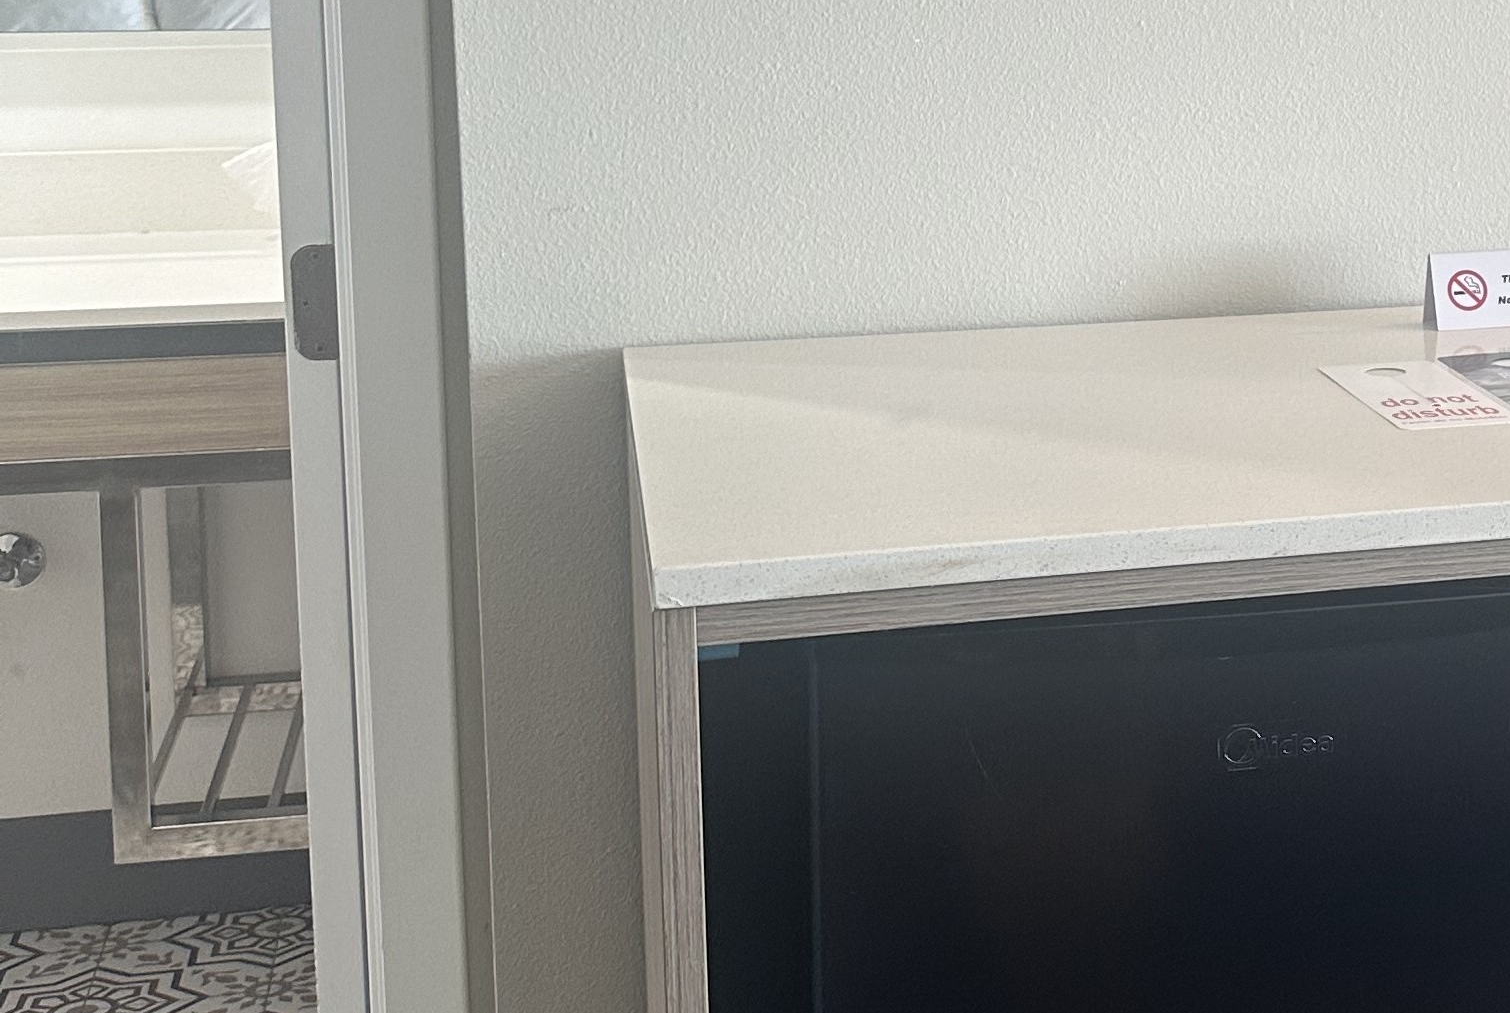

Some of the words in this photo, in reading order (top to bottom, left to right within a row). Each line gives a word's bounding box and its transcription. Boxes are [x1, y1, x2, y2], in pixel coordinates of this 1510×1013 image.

[1381, 397, 1419, 408] do
[1426, 393, 1478, 404] not
[1392, 404, 1500, 421] disturb
